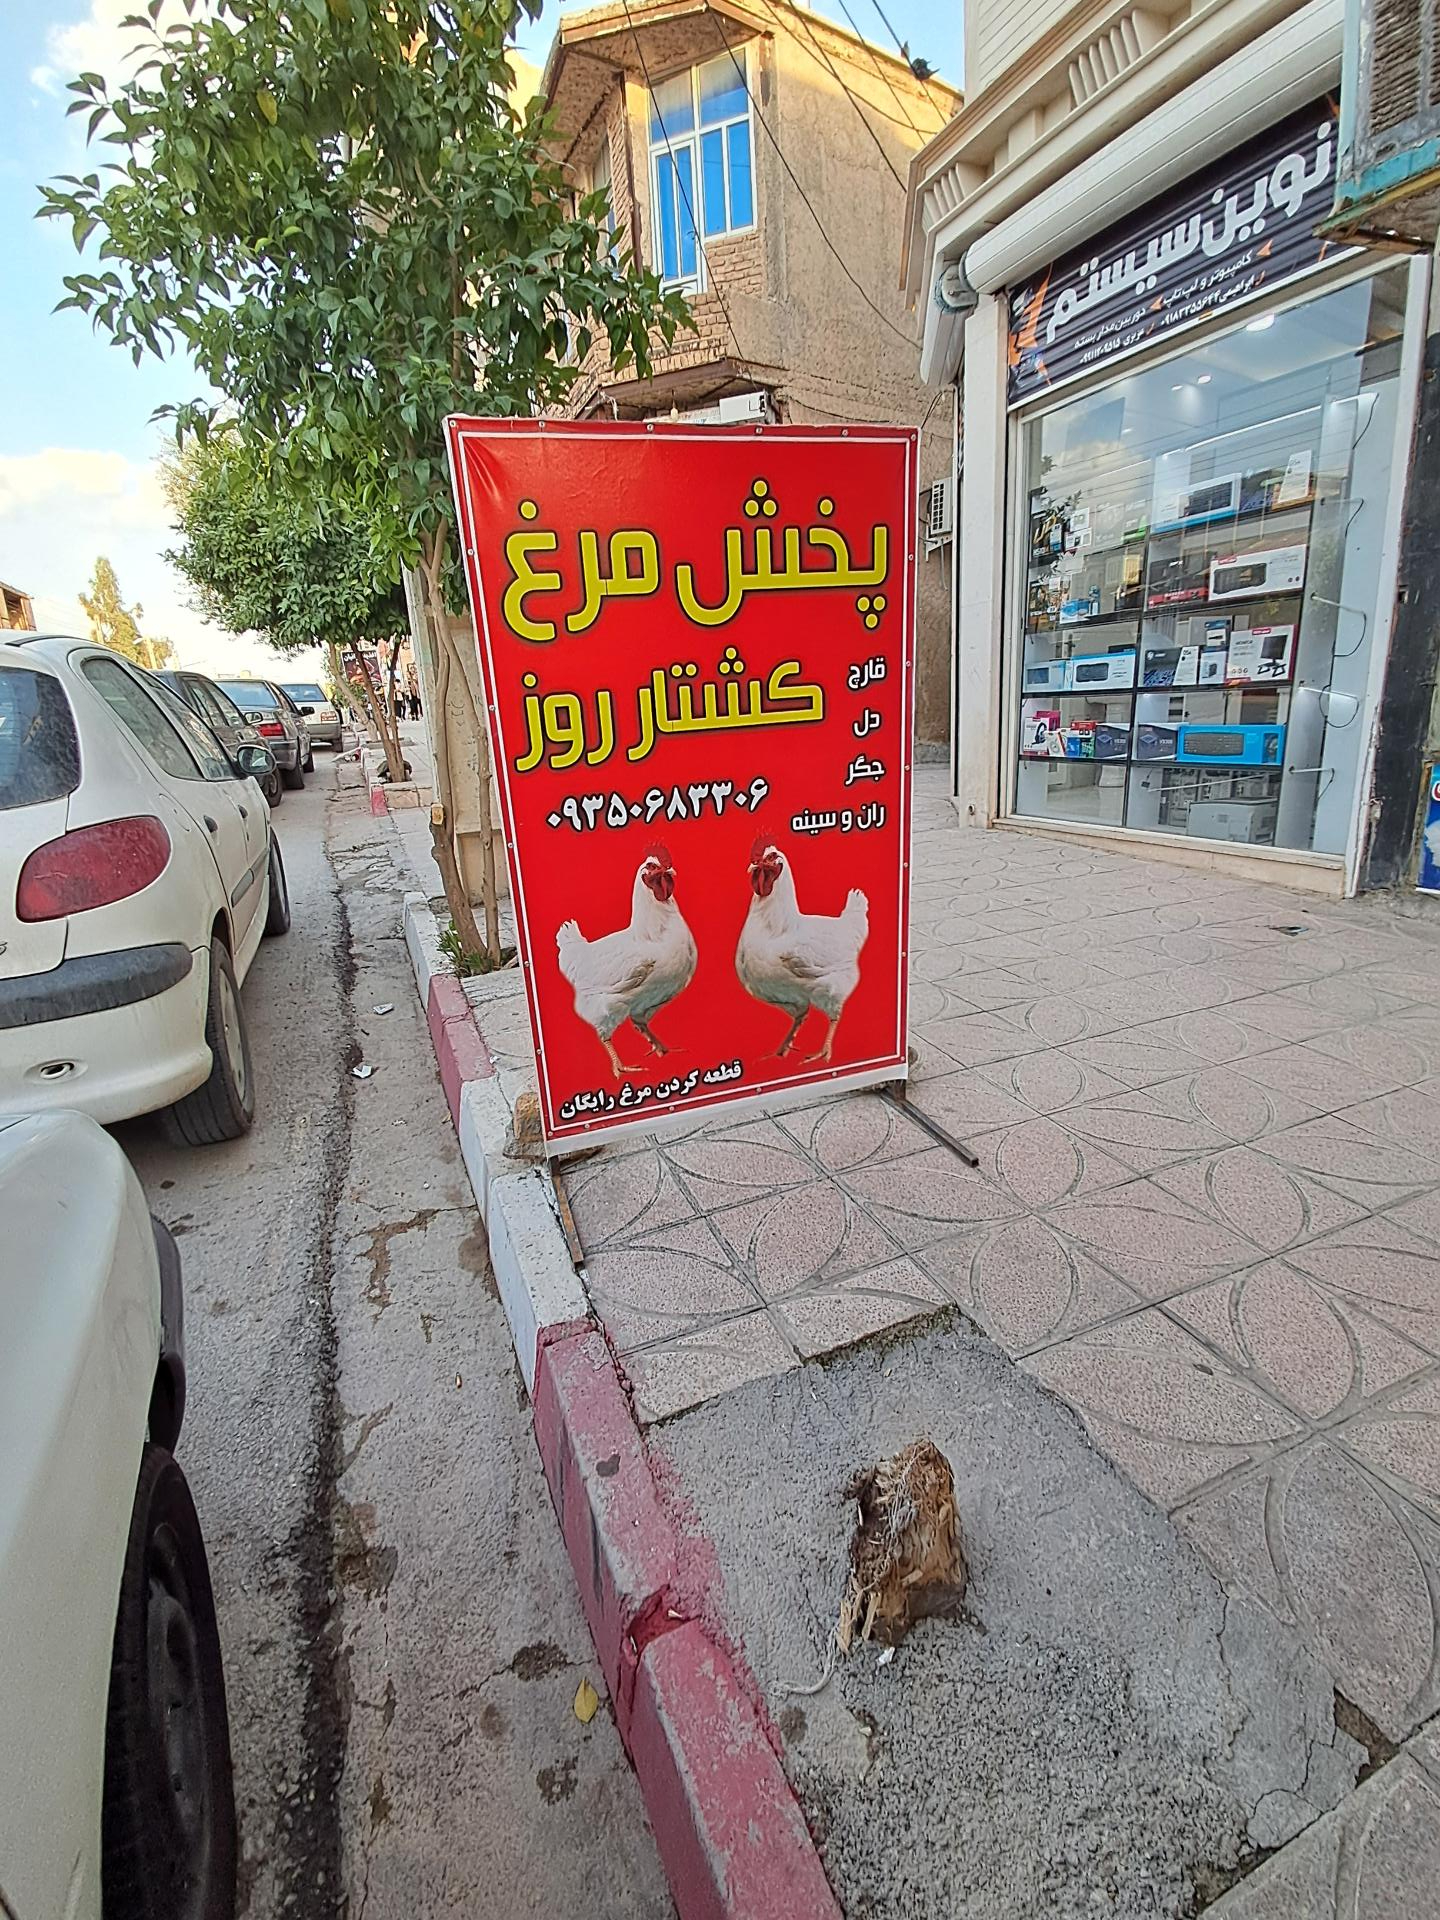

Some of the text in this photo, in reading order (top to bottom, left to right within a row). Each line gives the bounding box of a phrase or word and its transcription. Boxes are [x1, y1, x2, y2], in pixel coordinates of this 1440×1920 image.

[1046, 121, 1331, 345] نوین سیستم
[1163, 249, 1254, 308] کامپیوتر و لپ تاپ
[1074, 307, 1146, 349] دوربین مدار بسته
[503, 479, 888, 642] پخش مرغ
[848, 656, 886, 689] قارچ
[515, 646, 824, 772] کشتار روز
[853, 708, 880, 737] دل
[845, 756, 885, 786] جگر
[547, 778, 769, 831] ۰۹۳۵۰۶۸۳۳۰۶
[791, 802, 885, 835] ران و سینه
[560, 1060, 742, 1119] قطعه کردن مرغ رایگان
